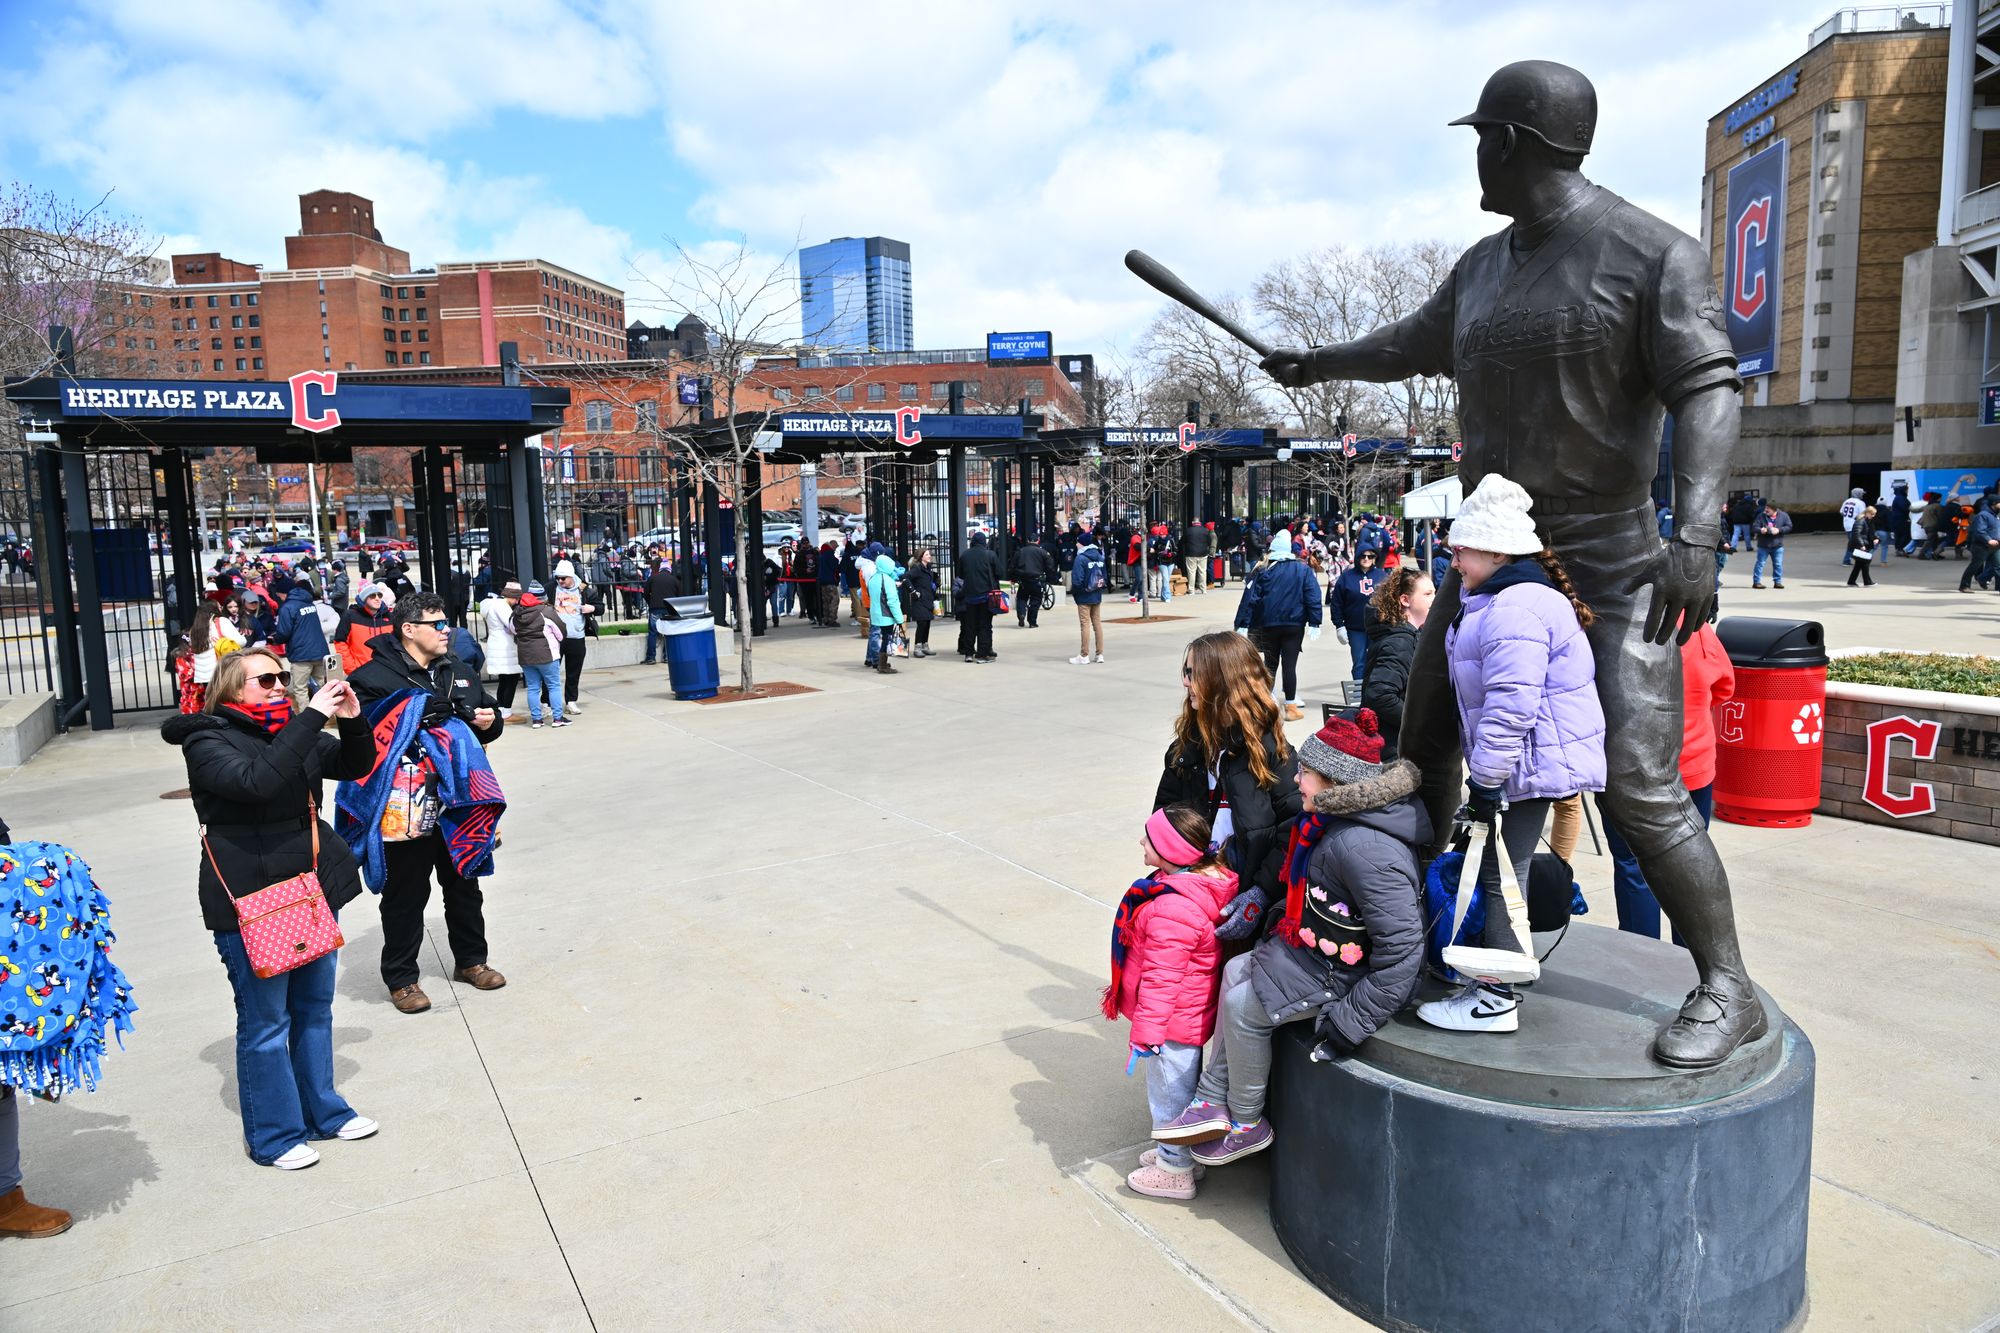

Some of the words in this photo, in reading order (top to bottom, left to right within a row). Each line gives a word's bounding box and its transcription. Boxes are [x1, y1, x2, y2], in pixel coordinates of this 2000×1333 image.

[1743, 115, 1776, 148] FIELD
[1732, 196, 1771, 321] C
[992, 342, 1016, 350] TERRY
[1018, 341, 1046, 349] COYNE
[67, 388, 196, 409] HERITAGE
[204, 391, 285, 410] PLAZA
[288, 369, 342, 433] C
[783, 418, 848, 432] HERITAGE
[851, 419, 893, 433] PLAZA
[895, 405, 922, 447] C
[1106, 432, 1148, 442] HERITE
[1150, 432, 1178, 442] PLAZA
[1178, 422, 1197, 452] C
[1322, 441, 1343, 450] PLAZA
[1343, 433, 1357, 458] C
[1451, 442, 1463, 462] C
[1843, 506, 1854, 518] 99
[1359, 577, 1375, 596] C
[300, 605, 317, 616] STAF
[1720, 701, 1745, 743] C
[1862, 714, 1942, 819] C
[1244, 902, 1260, 922] C
